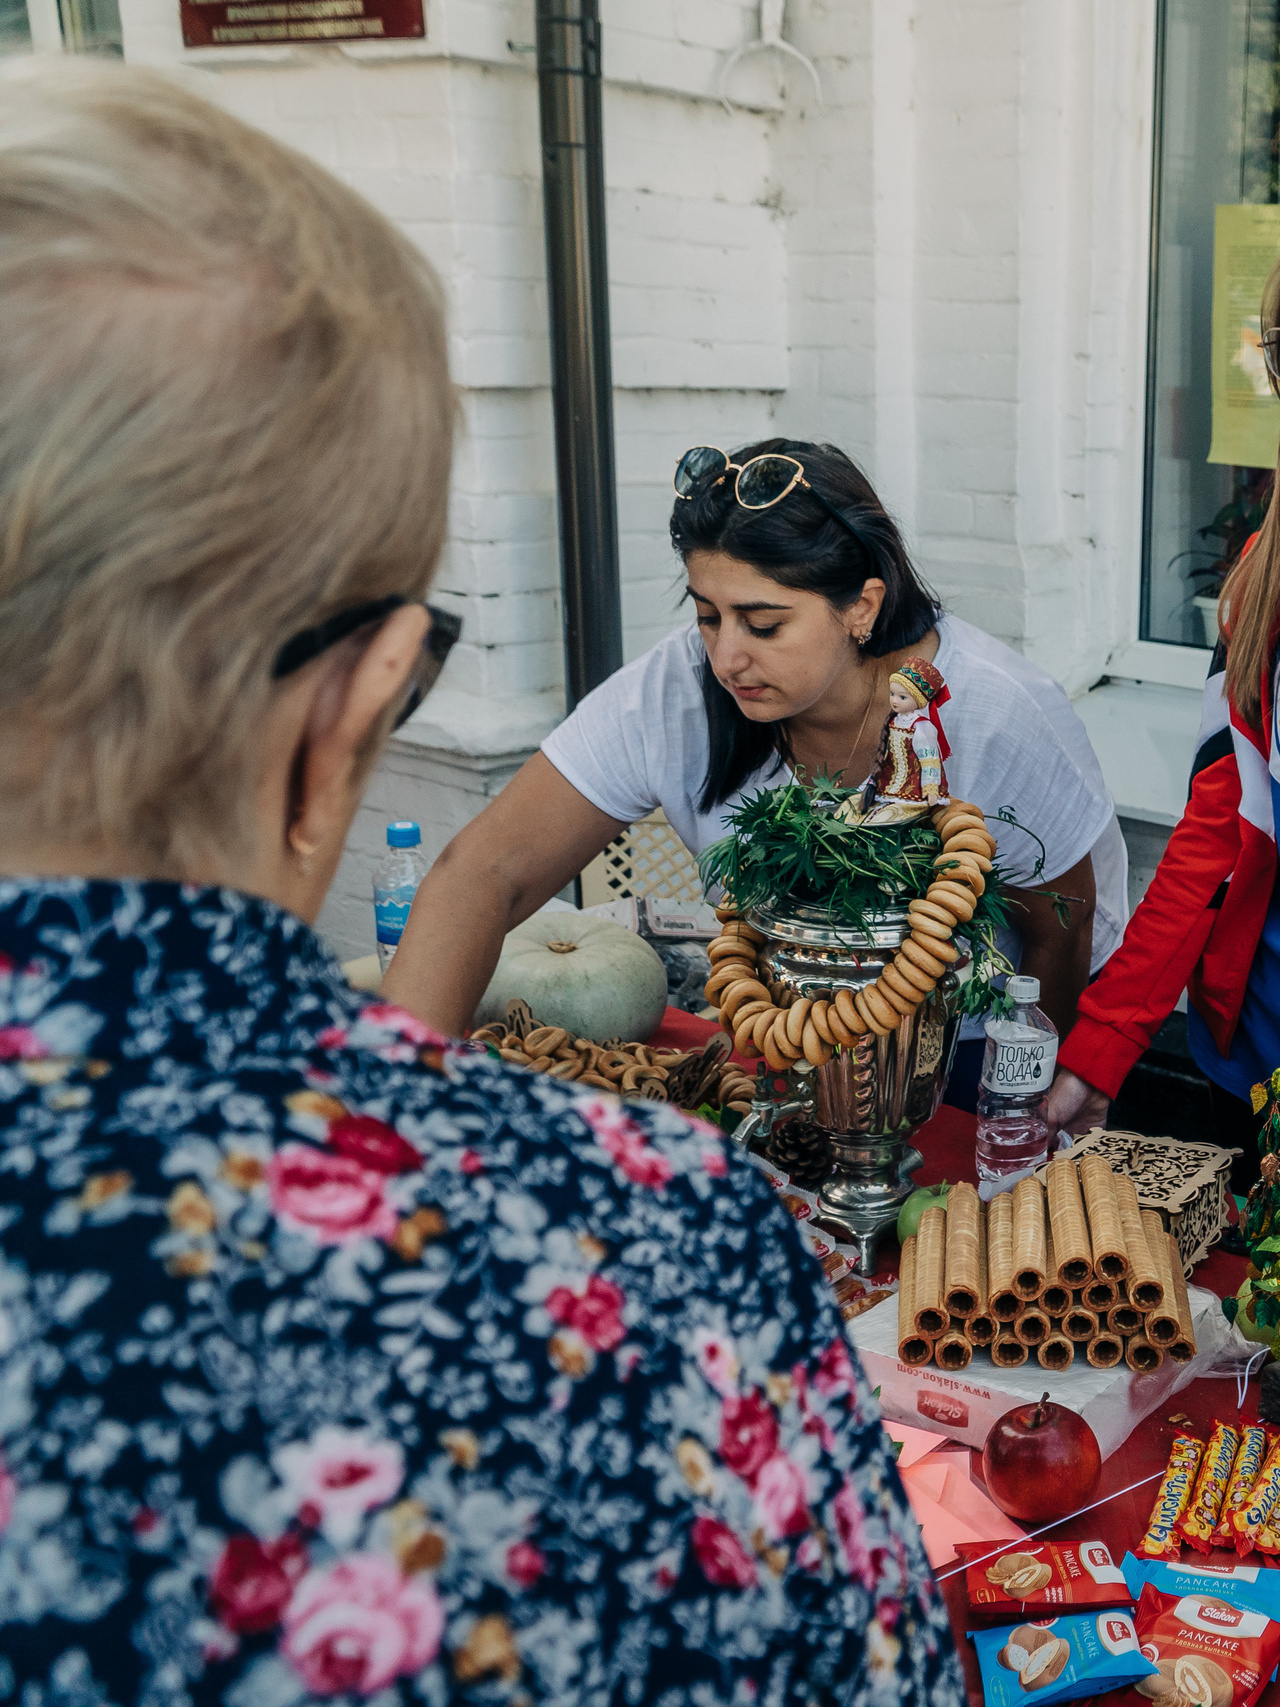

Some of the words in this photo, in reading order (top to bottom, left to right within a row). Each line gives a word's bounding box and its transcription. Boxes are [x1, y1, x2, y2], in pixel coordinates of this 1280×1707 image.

[999, 1044, 1045, 1063] ТОЛЬКО
[996, 1062, 1033, 1082] ВОДА
[896, 1363, 991, 1400] www.slakon.com
[1147, 1473, 1188, 1543] Чикита
[1062, 1550, 1082, 1578] PANCAKE
[1175, 1576, 1238, 1591] PANCAKE
[1201, 1606, 1237, 1624] Slakon
[1079, 1620, 1100, 1659] PANCAKE
[1177, 1629, 1240, 1652] PANCAKE
[1203, 1645, 1233, 1657] ВЫПЕЧКА
